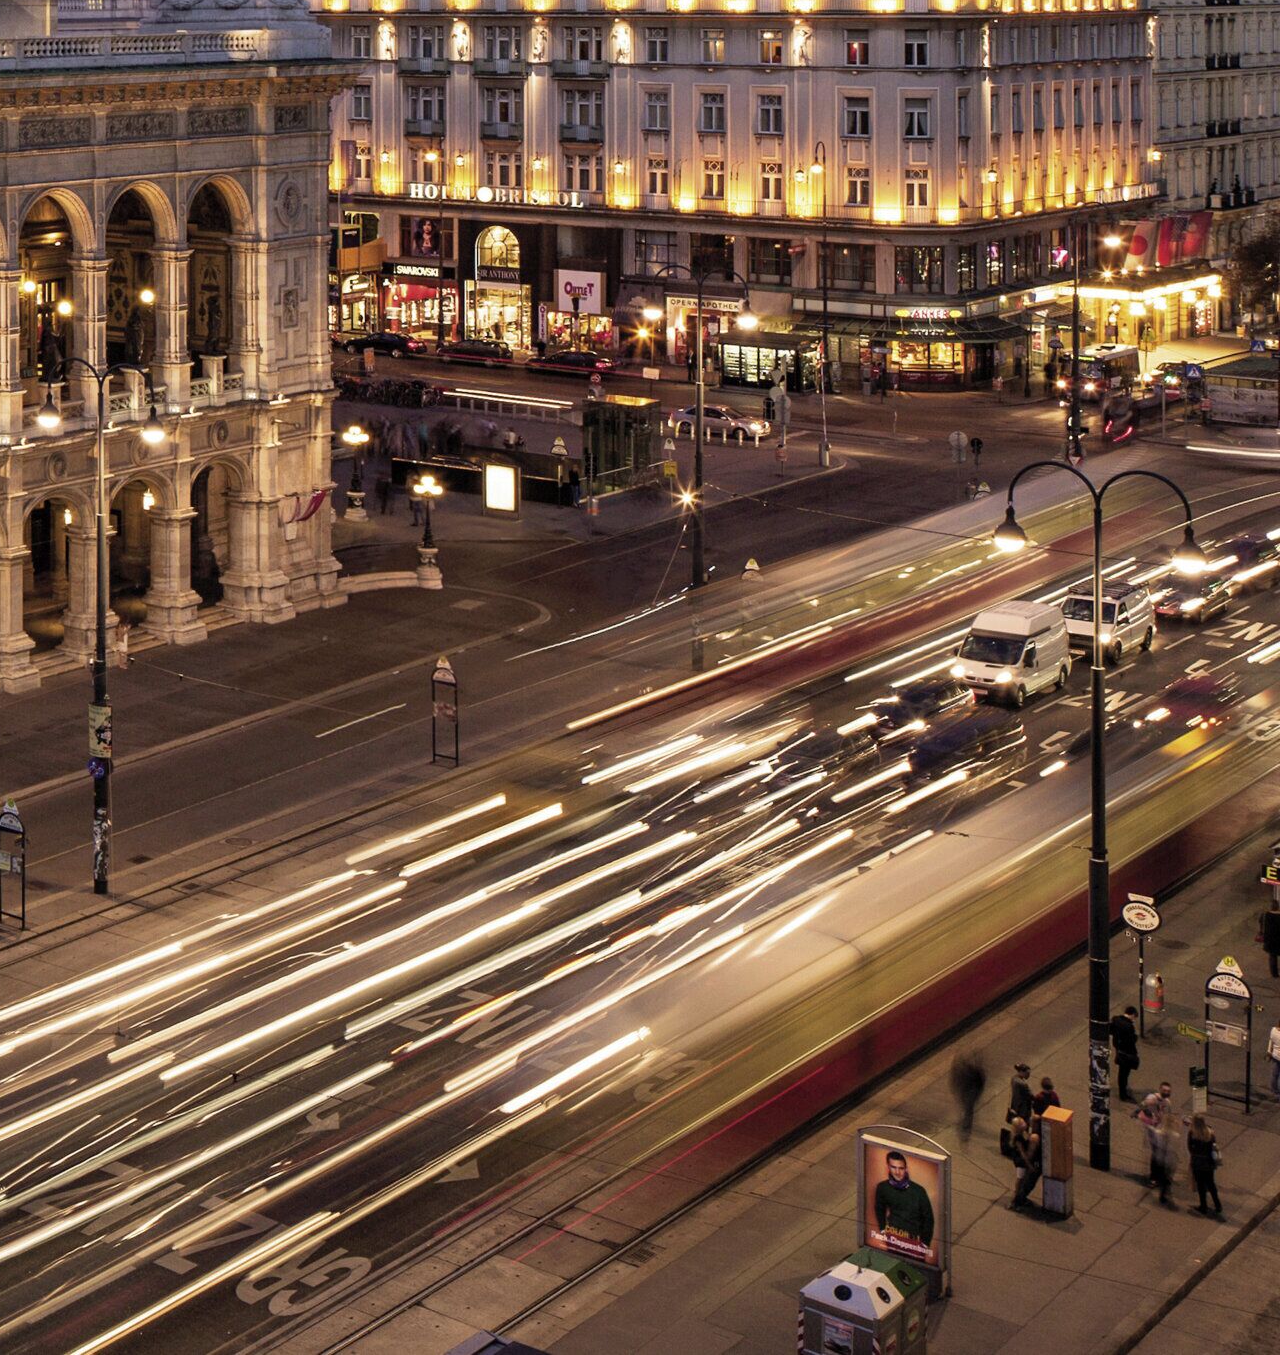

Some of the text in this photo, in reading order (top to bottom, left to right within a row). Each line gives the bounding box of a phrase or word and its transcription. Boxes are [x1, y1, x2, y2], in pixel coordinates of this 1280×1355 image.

[396, 265, 439, 277] SWAROVSKI
[490, 269, 519, 279] ANTHONY
[701, 301, 739, 310] APOTHEK
